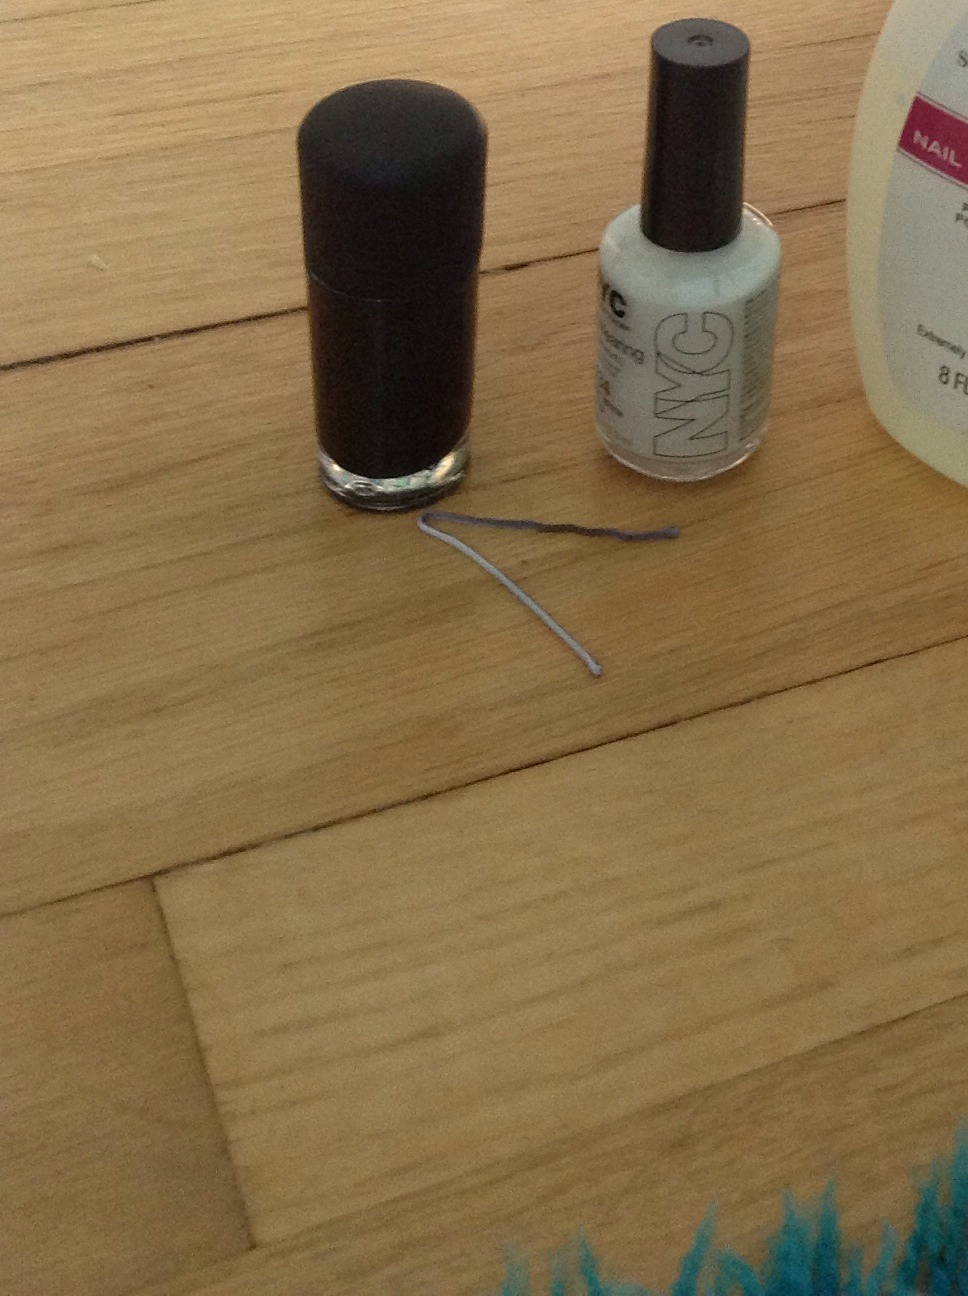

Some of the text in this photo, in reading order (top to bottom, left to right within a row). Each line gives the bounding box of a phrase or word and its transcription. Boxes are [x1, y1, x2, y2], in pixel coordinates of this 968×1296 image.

[912, 130, 963, 169] NAIL
[653, 311, 735, 459] NYC
[938, 365, 951, 385] 8
